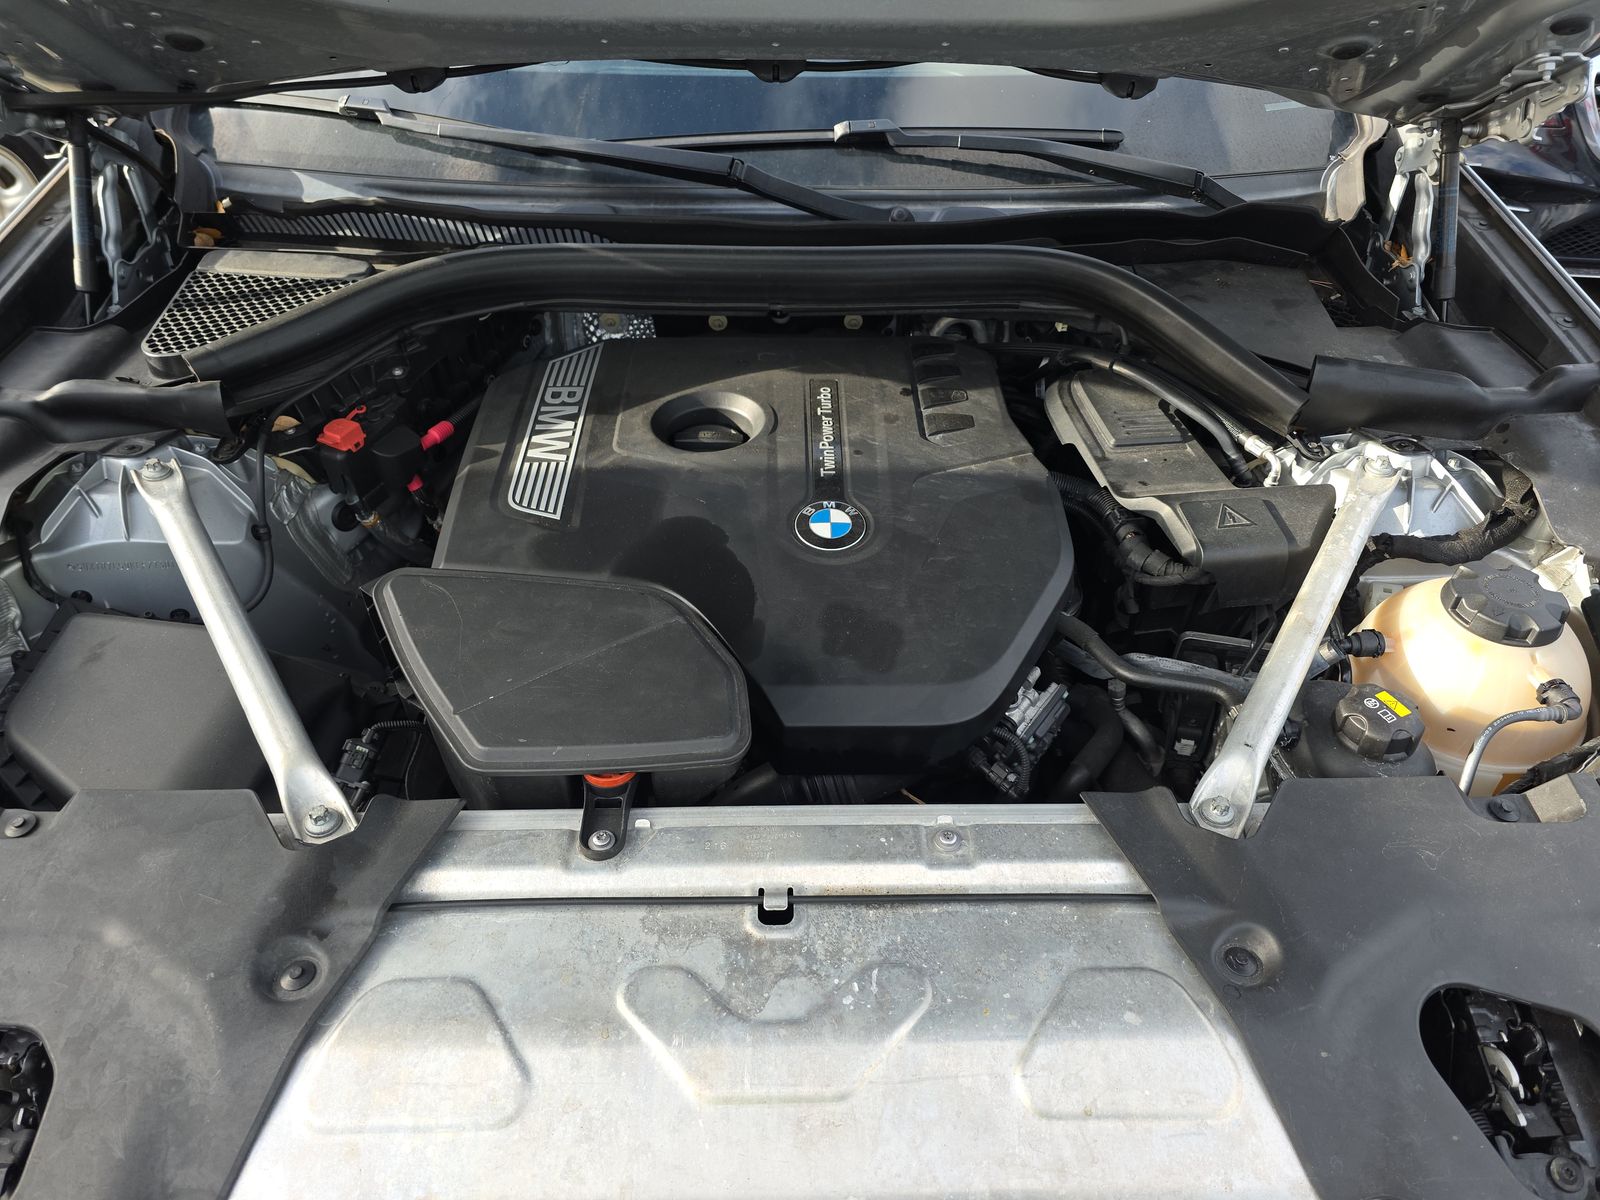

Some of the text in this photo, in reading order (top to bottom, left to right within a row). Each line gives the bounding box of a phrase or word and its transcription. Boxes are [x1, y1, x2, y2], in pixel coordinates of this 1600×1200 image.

[817, 386, 832, 416] Turbo
[527, 387, 584, 461] BMW
[802, 501, 858, 516] BMW
